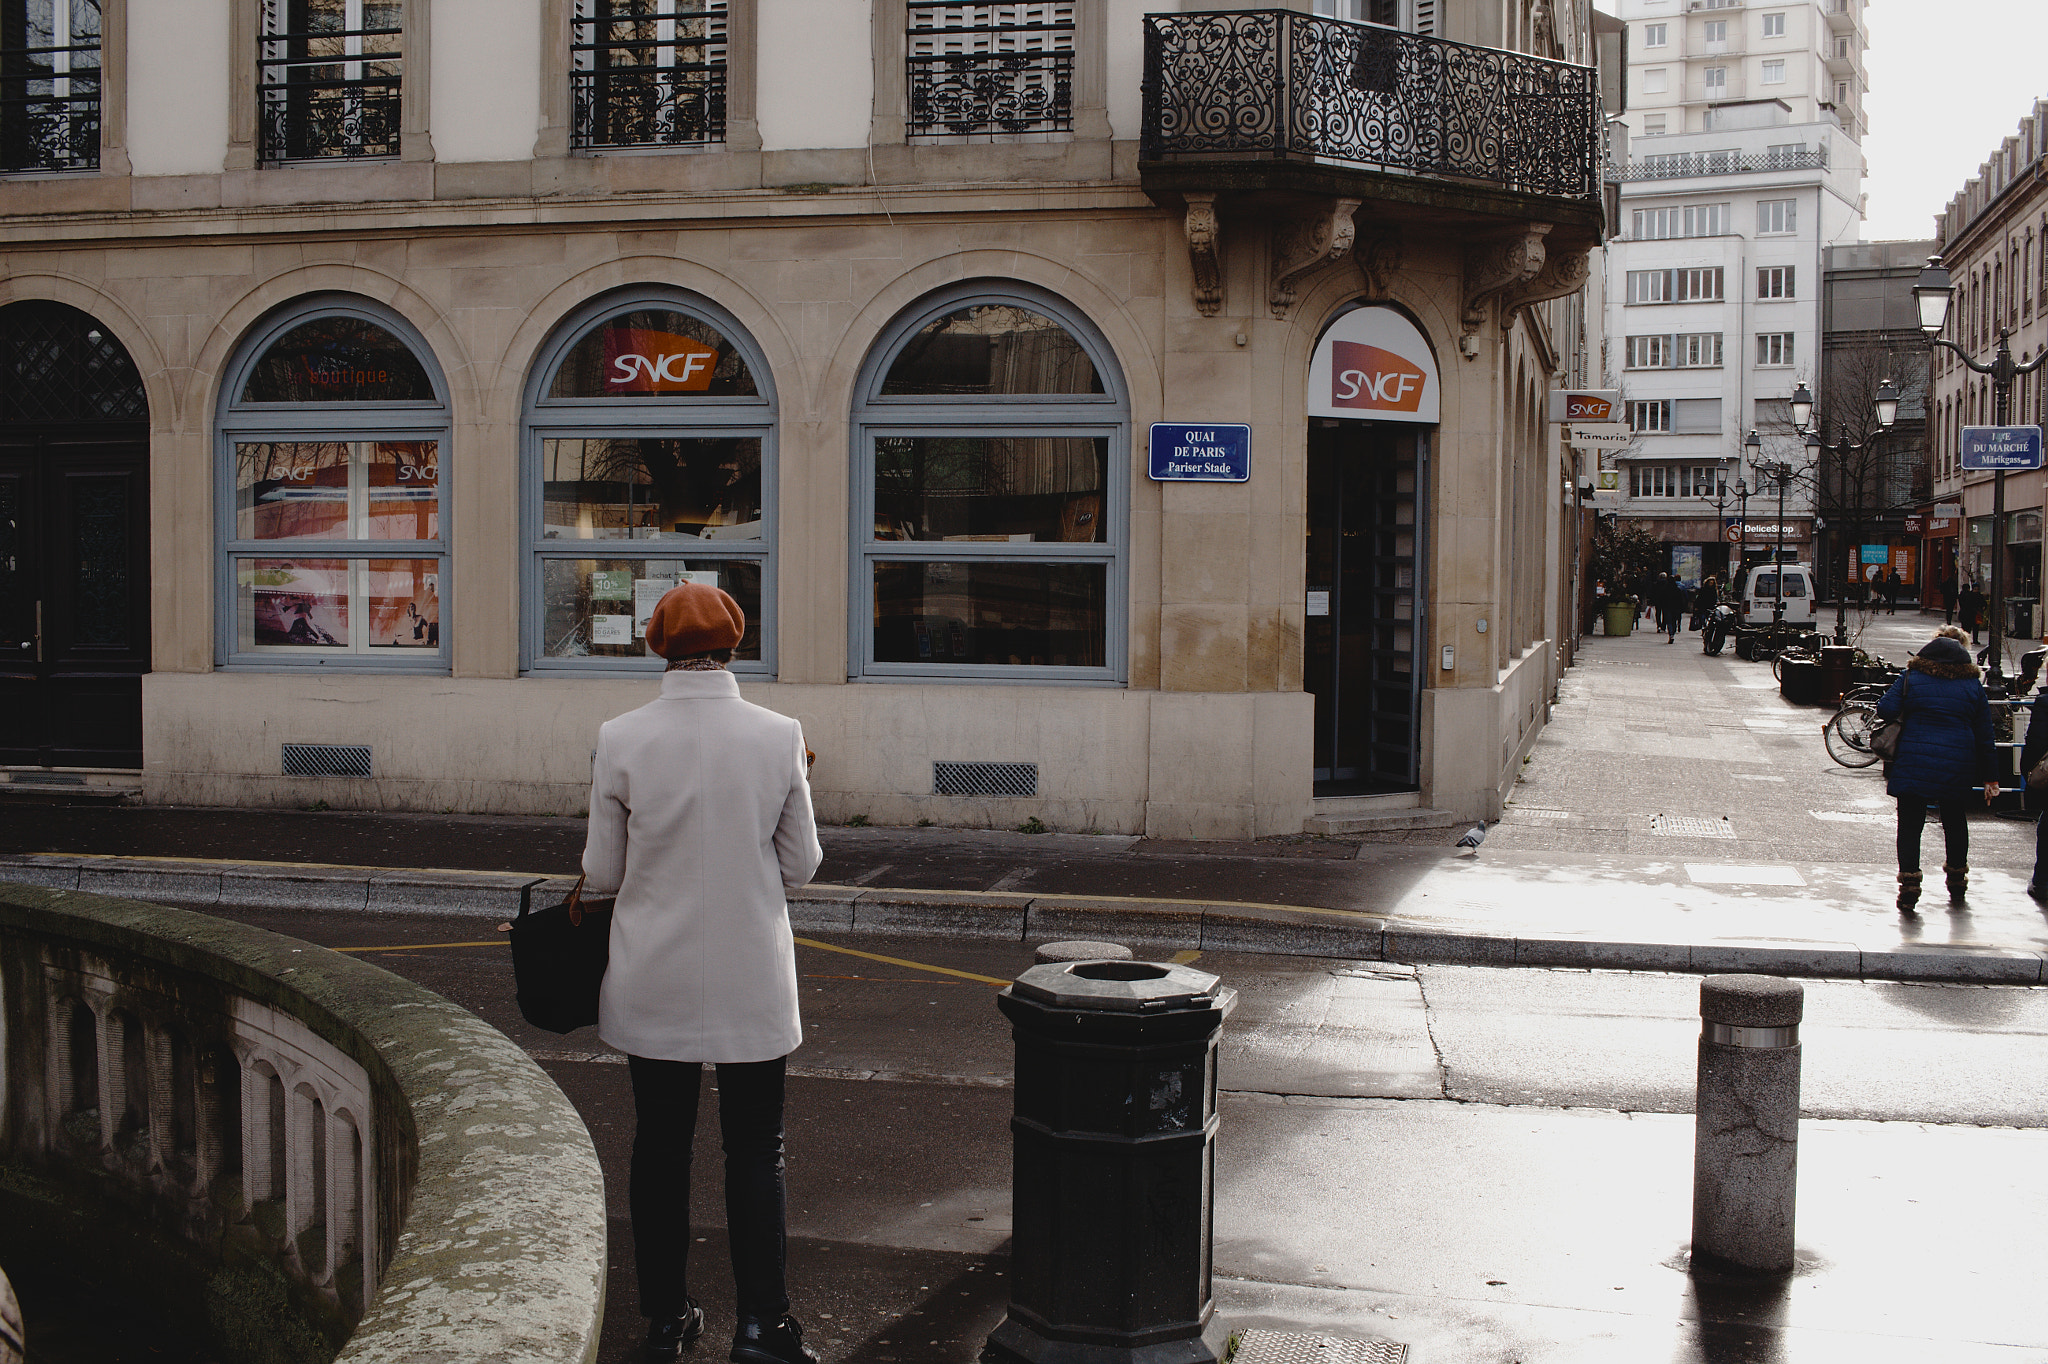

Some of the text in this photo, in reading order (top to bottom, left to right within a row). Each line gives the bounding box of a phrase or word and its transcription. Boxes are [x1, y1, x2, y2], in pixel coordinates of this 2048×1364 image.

[610, 353, 712, 383] SNCF
[311, 366, 388, 387] boutique
[1336, 369, 1420, 403] SNCF
[1569, 403, 1610, 416] SNCF
[1185, 431, 1215, 444] QUAI
[1174, 446, 1226, 458] DE PARIS
[1973, 442, 2030, 453] DU MARCHÉ
[271, 466, 316, 481] SNCF
[1168, 461, 1231, 473] Pariser Stade
